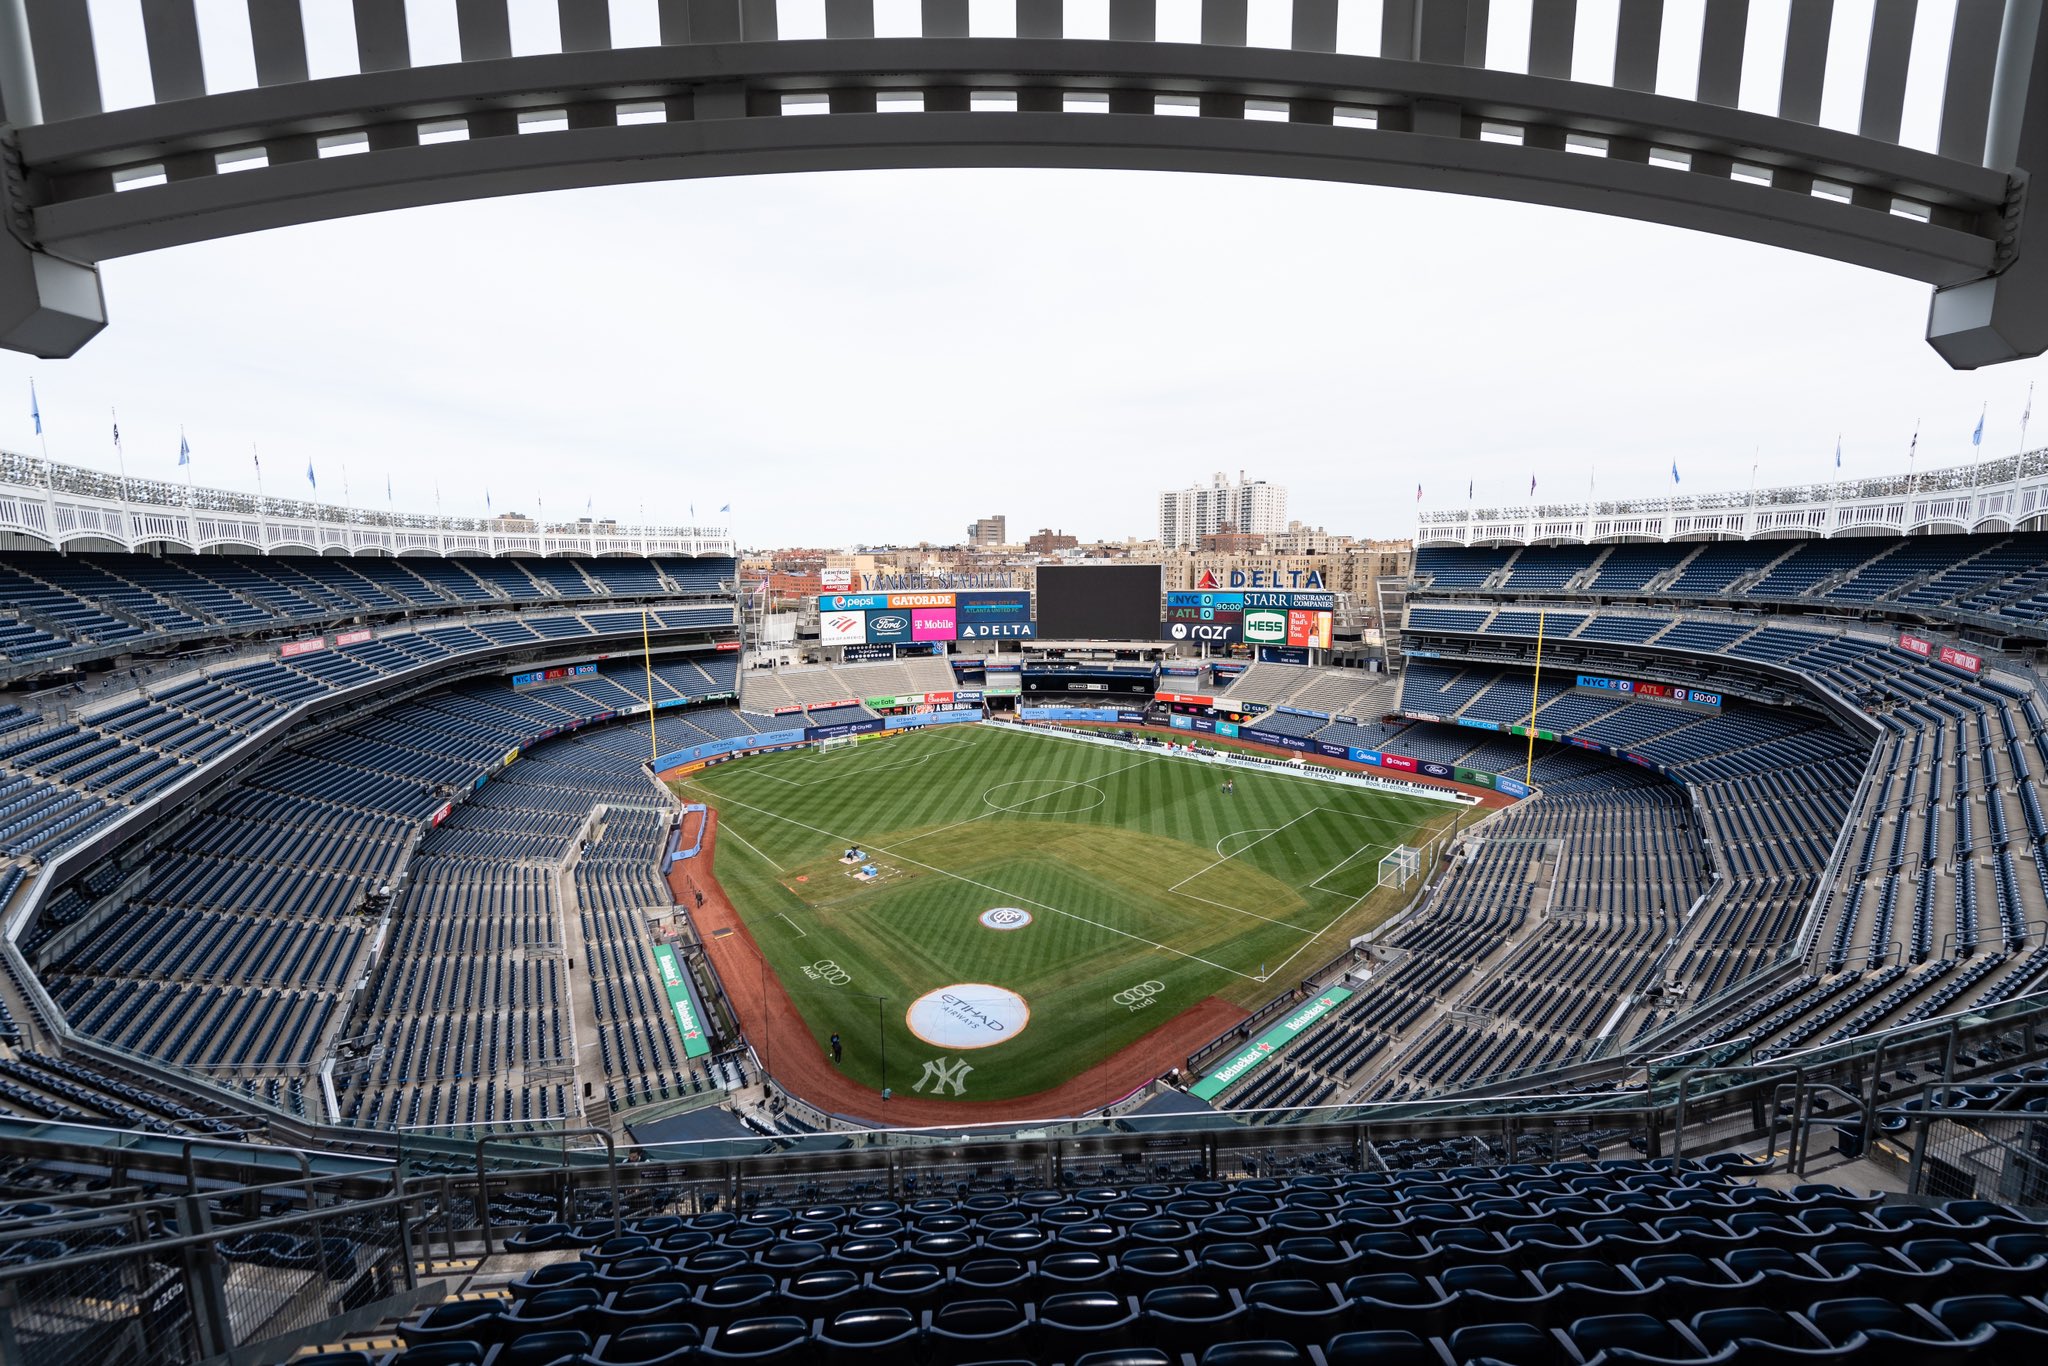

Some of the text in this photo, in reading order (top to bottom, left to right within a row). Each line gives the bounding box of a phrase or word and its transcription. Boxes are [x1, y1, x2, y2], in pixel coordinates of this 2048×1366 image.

[862, 572, 1012, 590] YANKEE STADIUM
[1230, 570, 1324, 589] DELTA
[848, 597, 874, 607] pepsi
[892, 596, 951, 606] GATORADE
[1176, 596, 1211, 604] NYC 0
[1244, 594, 1288, 606] STARR
[1176, 609, 1198, 618] ATL
[915, 620, 954, 629] T Mobile
[1248, 621, 1282, 631] HESS
[980, 625, 1031, 636] DELTA
[1192, 626, 1232, 640] razr
[1583, 678, 1604, 687] NYC
[1640, 685, 1660, 695] ATL
[1694, 693, 1717, 704] 90:00
[1460, 719, 1498, 729] NYCFC.COM
[712, 741, 734, 749] ETIHAD
[1322, 744, 1344, 753] ETIHAD
[663, 754, 682, 763] ETIHAD
[1304, 771, 1336, 780] ETIHAD
[1389, 784, 1424, 794] etihad.com
[800, 966, 821, 980] Audi
[1129, 997, 1157, 1012] Audi
[942, 994, 1004, 1031] ETIHAD
[942, 1006, 979, 1029] AIRWAYS
[1285, 1003, 1326, 1031] Heineken
[1215, 1049, 1262, 1082] Heineken
[912, 1056, 974, 1096] NY
